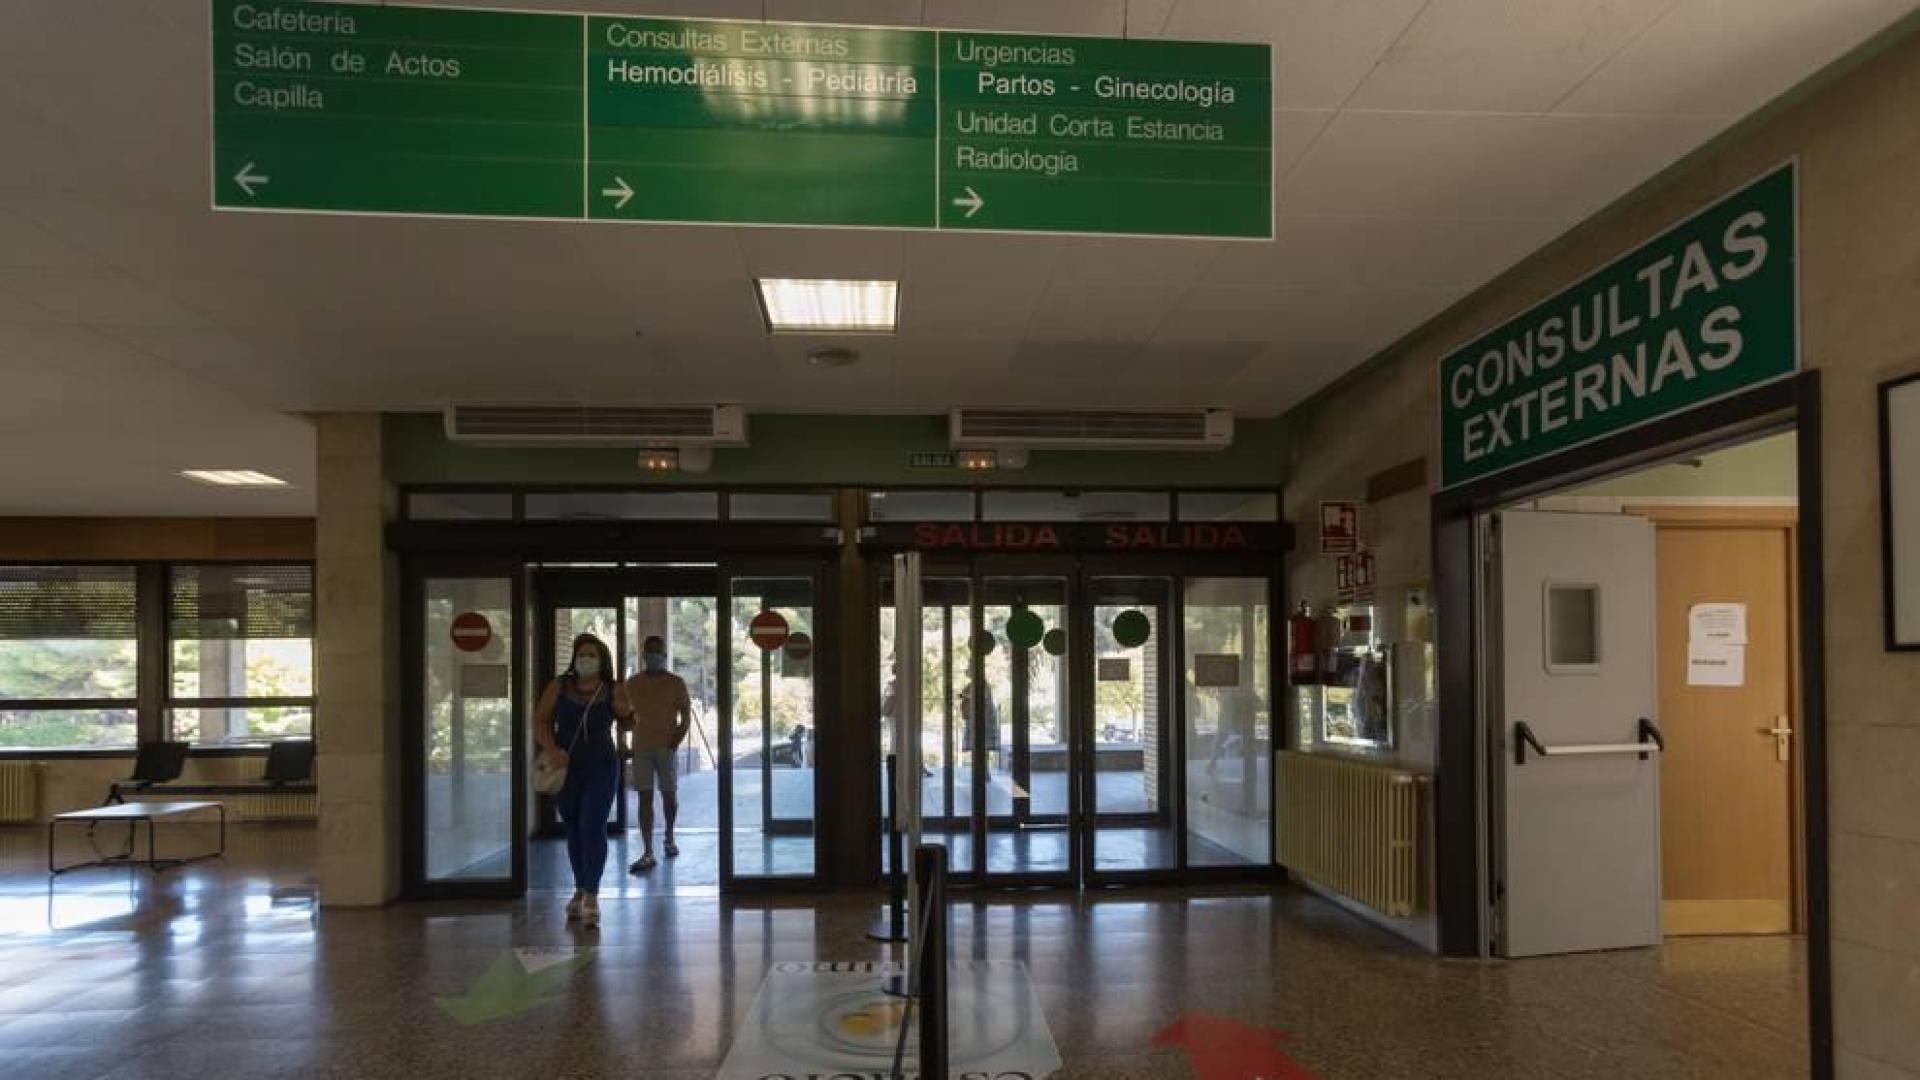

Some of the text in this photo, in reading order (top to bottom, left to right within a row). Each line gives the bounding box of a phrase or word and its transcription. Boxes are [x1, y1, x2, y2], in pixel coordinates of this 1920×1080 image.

[606, 24, 849, 56] Consultas Externas
[956, 39, 1076, 67] Urgencias
[234, 43, 461, 77] Salón de Actos
[607, 59, 768, 89] Hemodiálisis
[233, 81, 324, 110] Capilla
[978, 71, 1056, 96] Partos
[956, 110, 1225, 141] Unidad Corta Estancia
[1450, 209, 1769, 409] CONSULTAS
[1462, 304, 1744, 463] EXTERNAS
[914, 522, 1246, 549] SALIDA SALIDA
